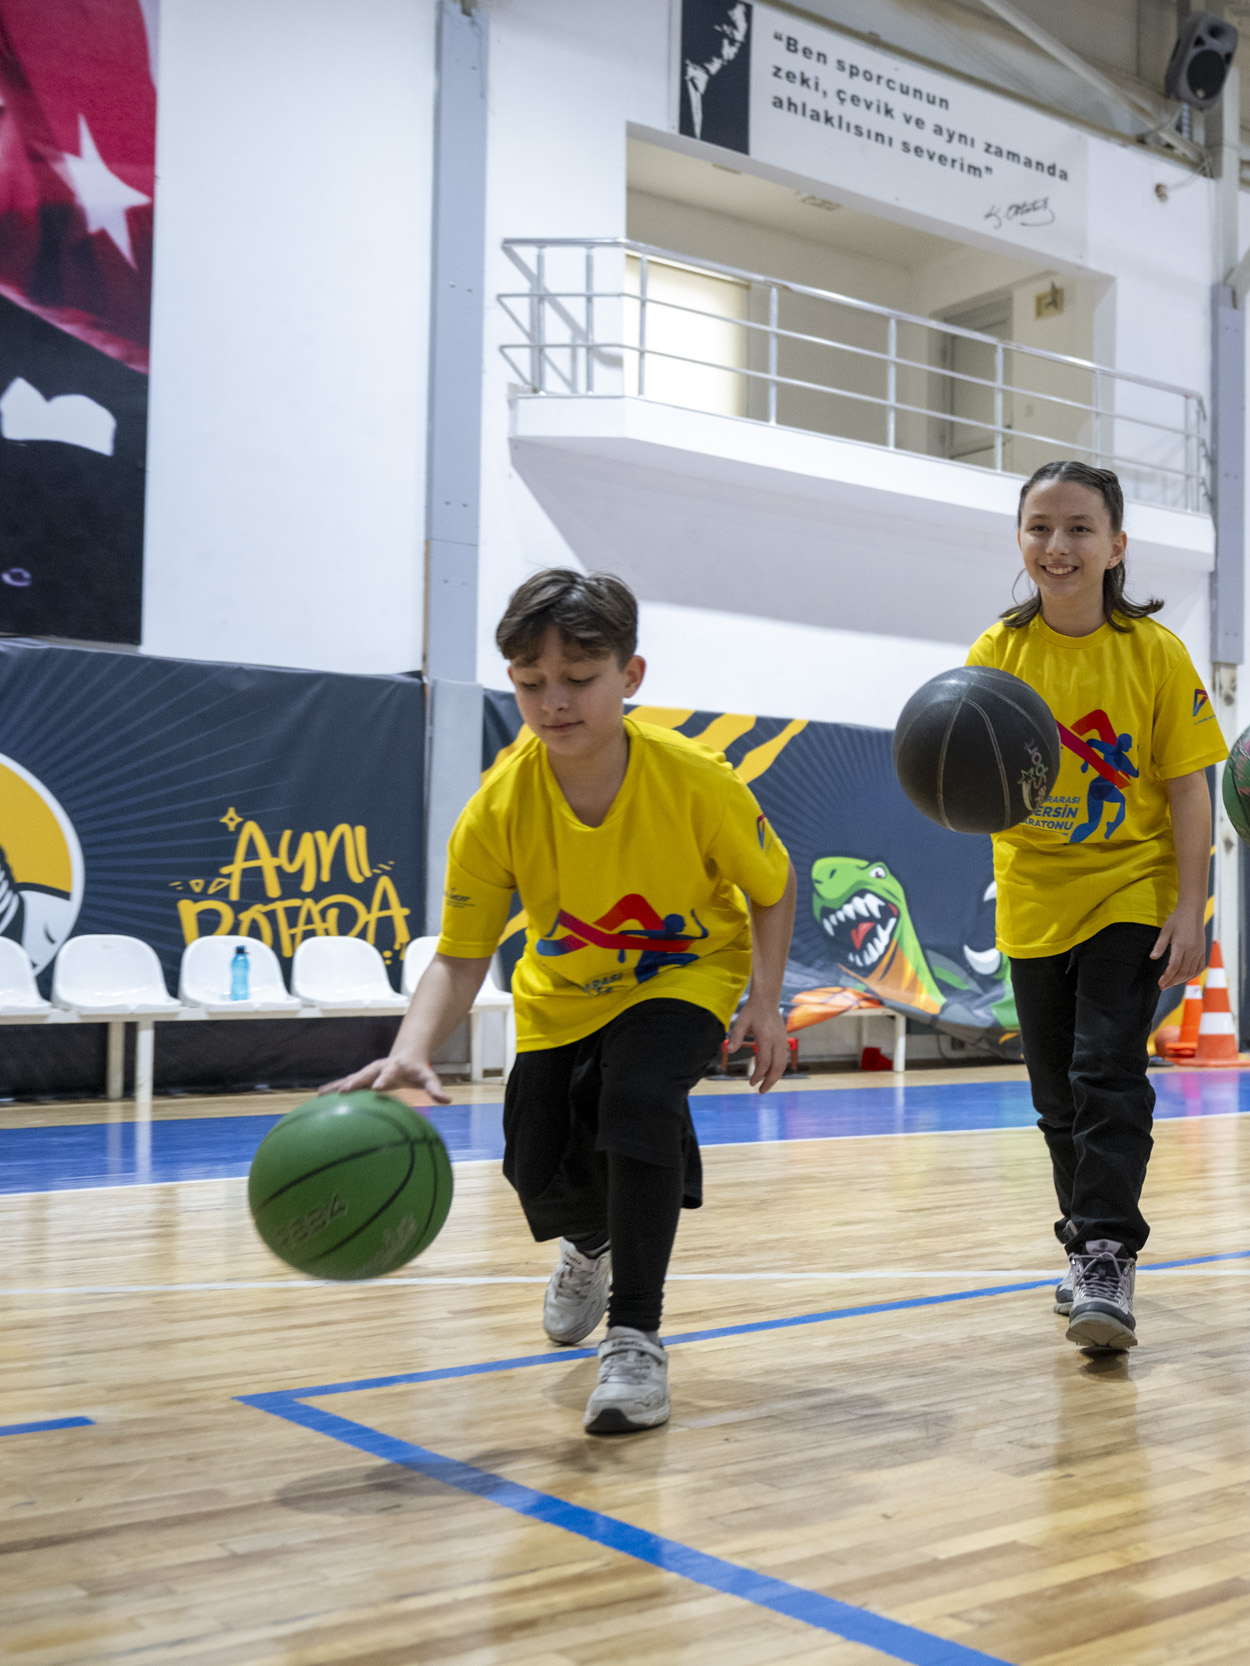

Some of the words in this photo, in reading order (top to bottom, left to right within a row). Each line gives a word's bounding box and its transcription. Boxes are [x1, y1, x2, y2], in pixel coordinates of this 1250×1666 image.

[836, 59, 950, 111] sporcunun
[771, 95, 893, 148] ahlaklısını
[772, 65, 827, 98] zeki,
[836, 88, 894, 120] çevik
[902, 111, 926, 131] ve
[933, 122, 975, 149] aynı
[984, 141, 1069, 182] zamanda
[1022, 818, 1074, 830] ARATONU
[1034, 804, 1079, 819] ERSİN
